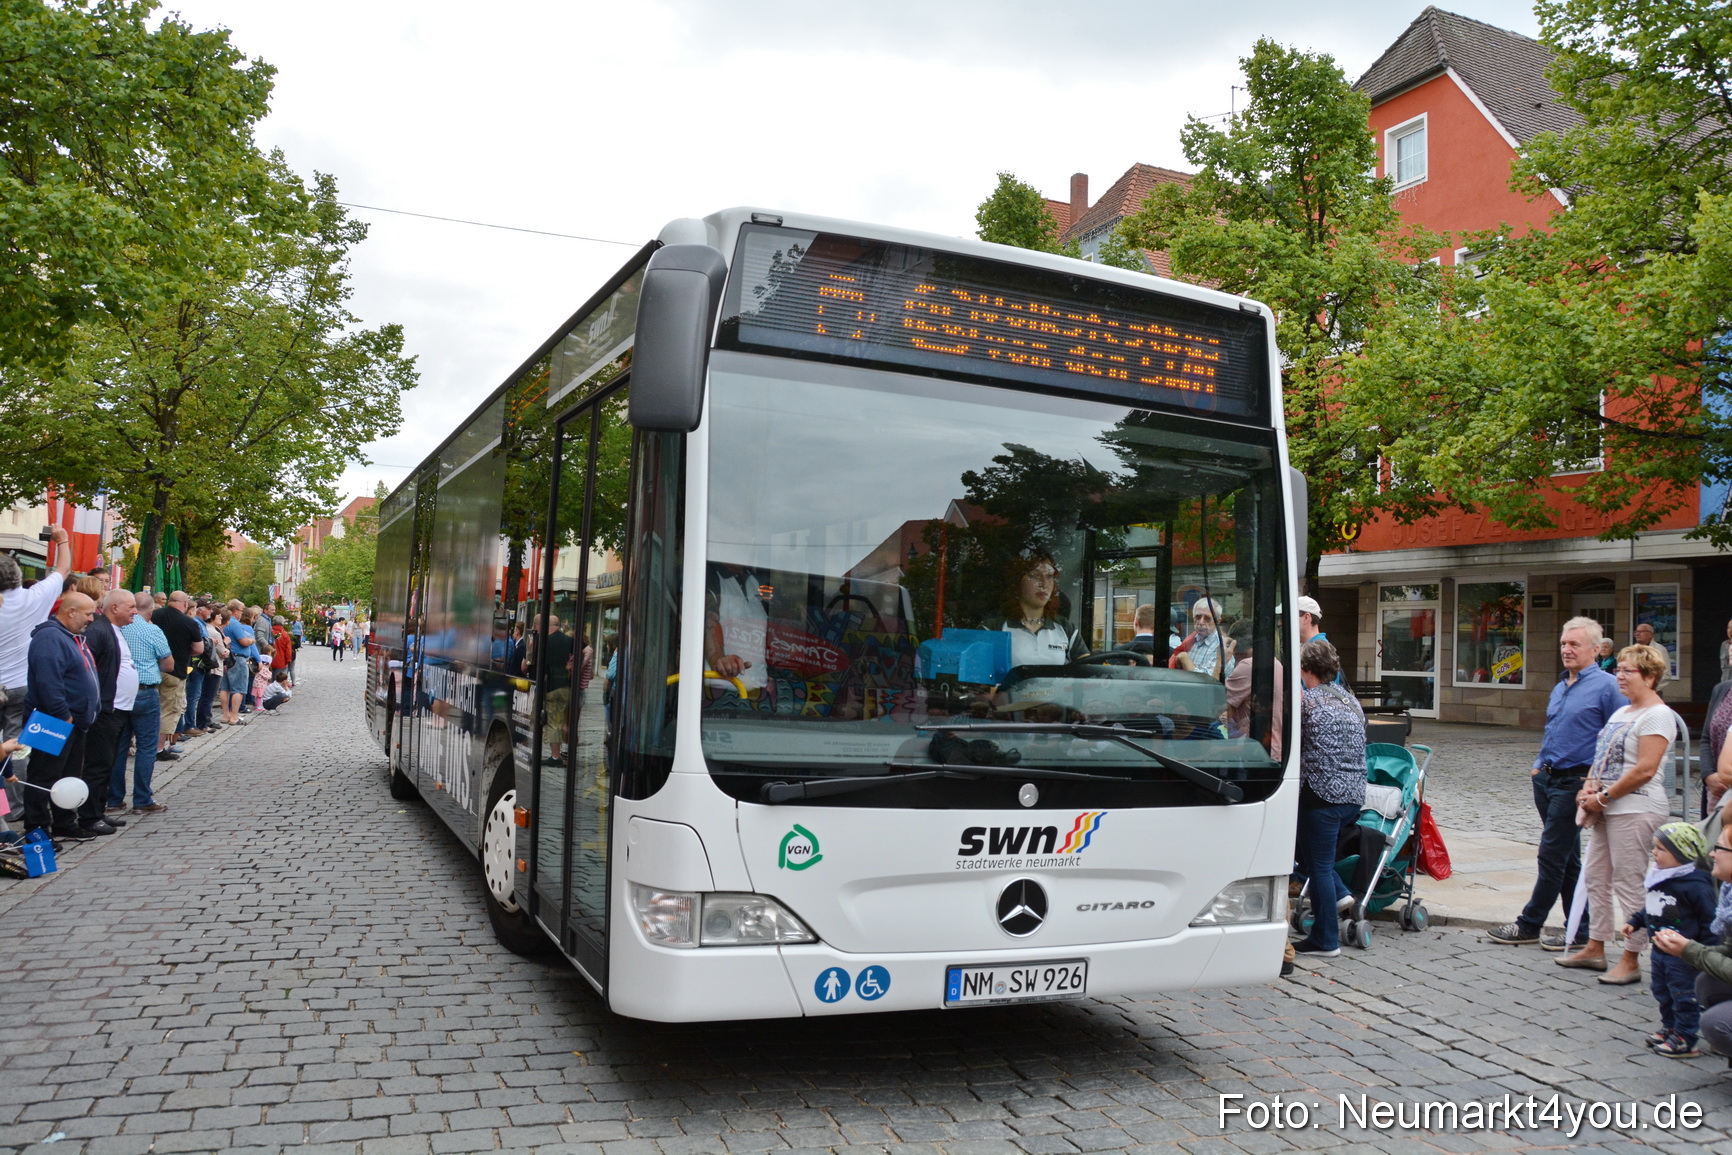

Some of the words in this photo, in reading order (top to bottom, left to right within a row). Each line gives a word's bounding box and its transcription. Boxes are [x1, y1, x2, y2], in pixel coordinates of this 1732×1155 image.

[957, 825, 1059, 856] swn
[787, 845, 811, 855] VGN
[955, 856, 1022, 870] stadtwerke
[1026, 854, 1082, 868] neumarkt
[1076, 900, 1156, 912] CITARO
[963, 971, 994, 996] NM
[1009, 969, 1039, 993] SW
[1043, 966, 1082, 991] 926
